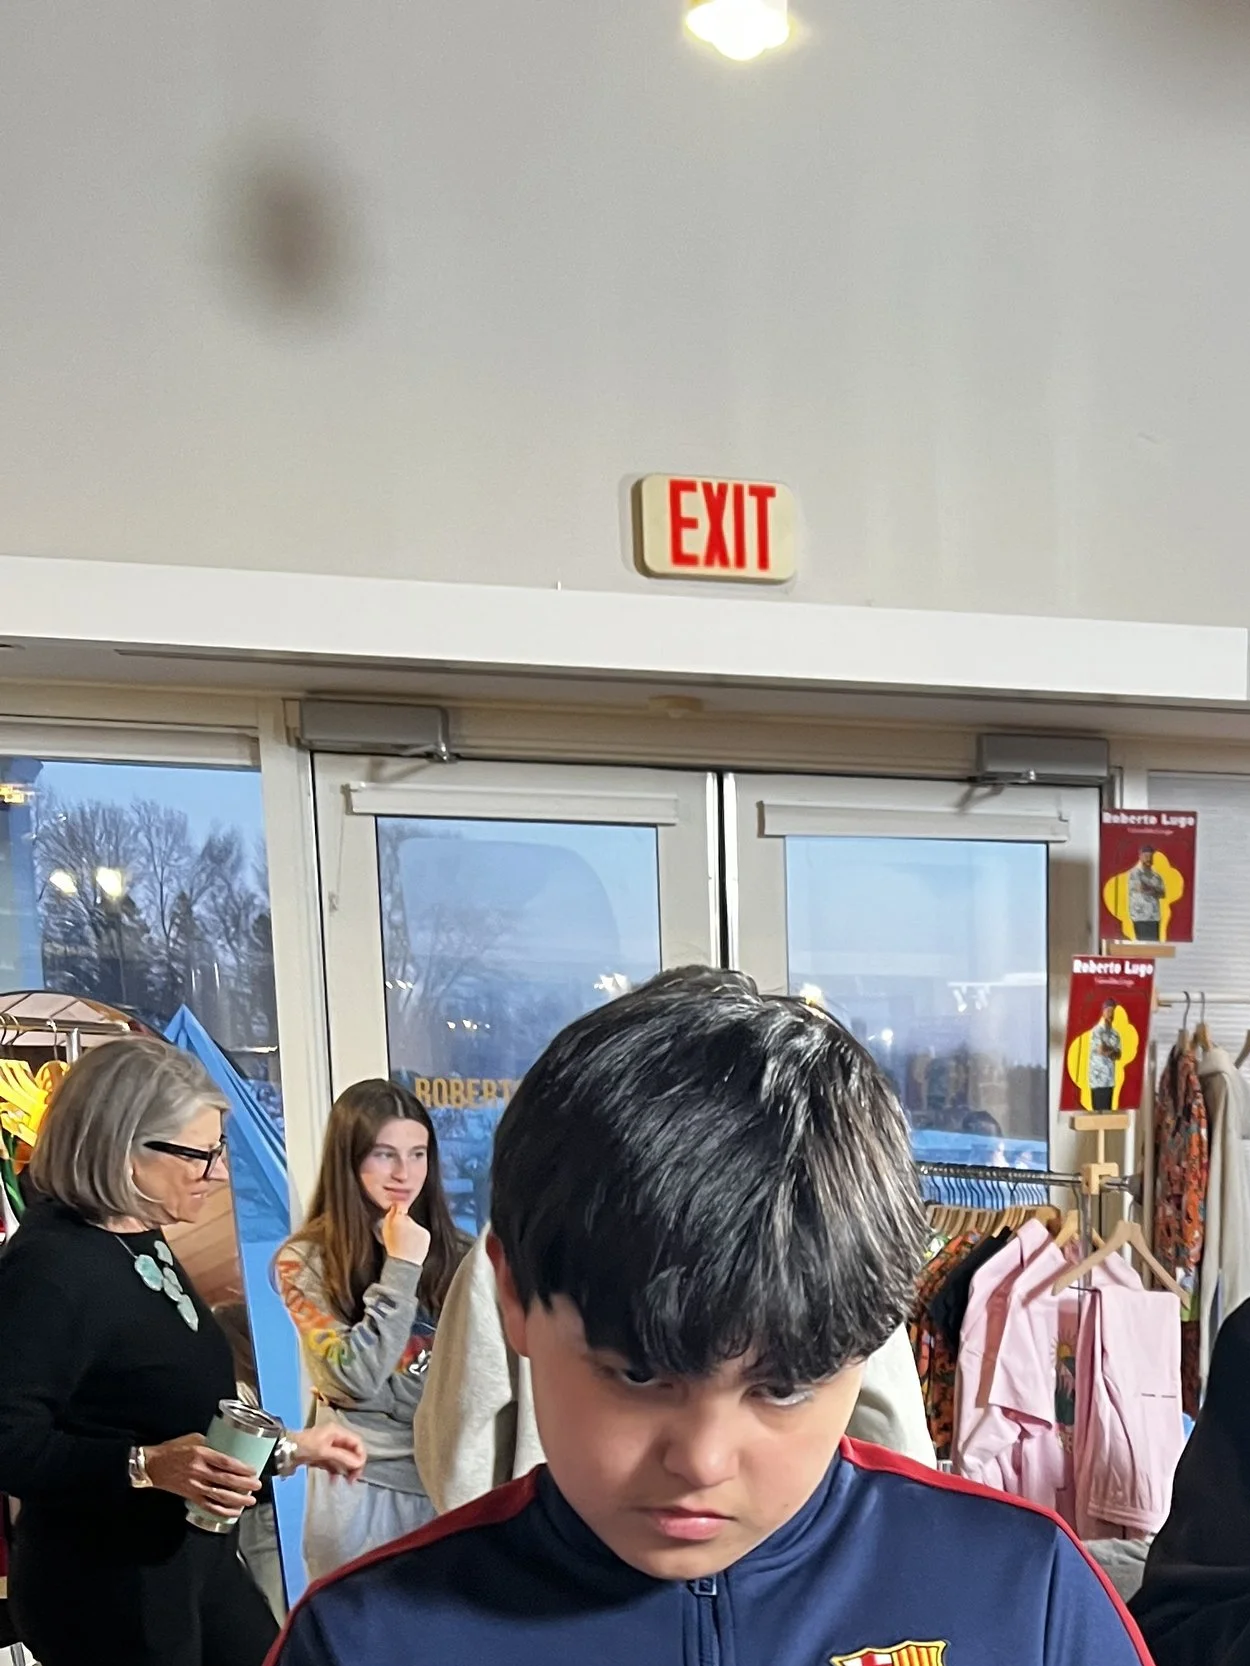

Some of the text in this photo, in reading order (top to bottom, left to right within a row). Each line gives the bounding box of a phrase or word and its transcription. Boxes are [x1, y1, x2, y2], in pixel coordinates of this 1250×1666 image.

[669, 479, 776, 571] EXIT
[1102, 811, 1195, 828] Roberto Lugo
[1073, 959, 1154, 978] Roberto Lugo
